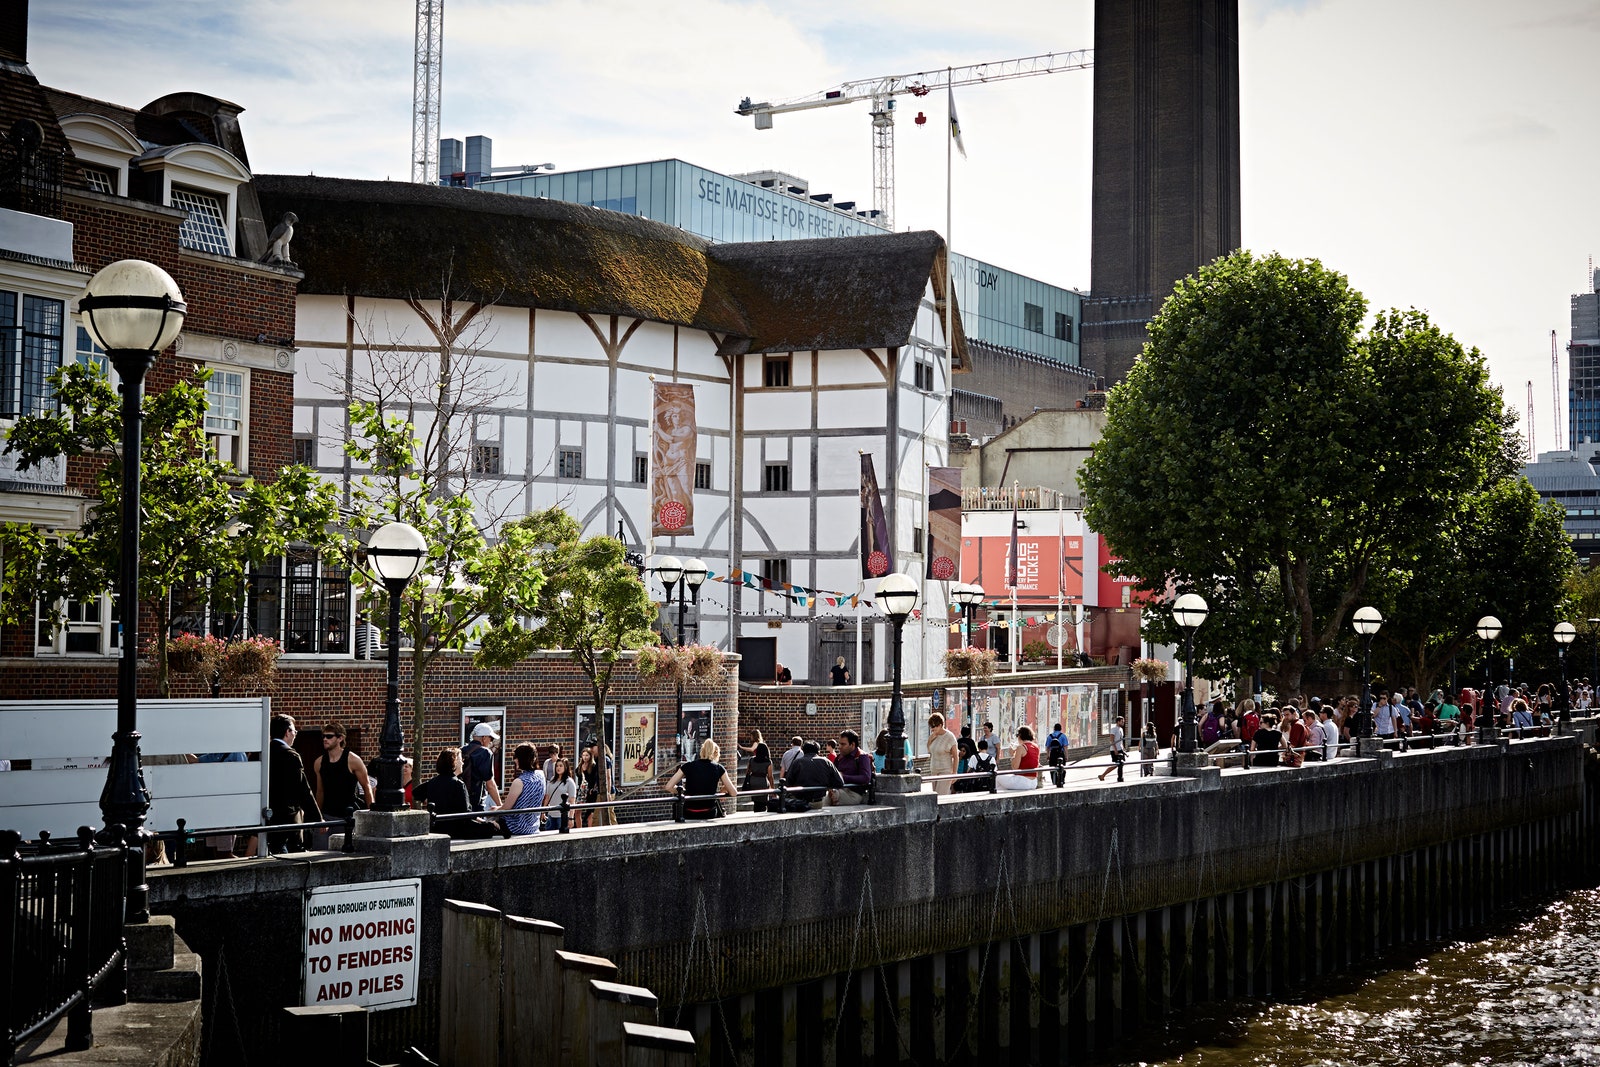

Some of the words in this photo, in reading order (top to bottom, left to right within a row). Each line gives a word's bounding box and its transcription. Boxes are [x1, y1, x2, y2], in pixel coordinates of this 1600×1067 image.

[698, 178, 721, 205] SEE
[725, 187, 778, 223] MATISSE
[782, 205, 805, 231] FOR
[808, 213, 834, 238] FREE
[951, 260, 966, 281] OIN
[969, 265, 998, 292] TODAY
[1005, 543, 1027, 557] 70
[1027, 543, 1038, 583] TICKETS
[624, 744, 641, 760] WAR
[309, 904, 336, 917] LONDON
[337, 901, 368, 914] BOROUGH
[368, 900, 377, 911] OF
[378, 896, 415, 910] SOUTHWARK
[308, 926, 333, 946] NO
[339, 917, 415, 943] MOORING
[309, 955, 332, 974] TO
[337, 945, 413, 971] FENDERS
[316, 981, 353, 1002] AND
[358, 973, 404, 996] PILES
